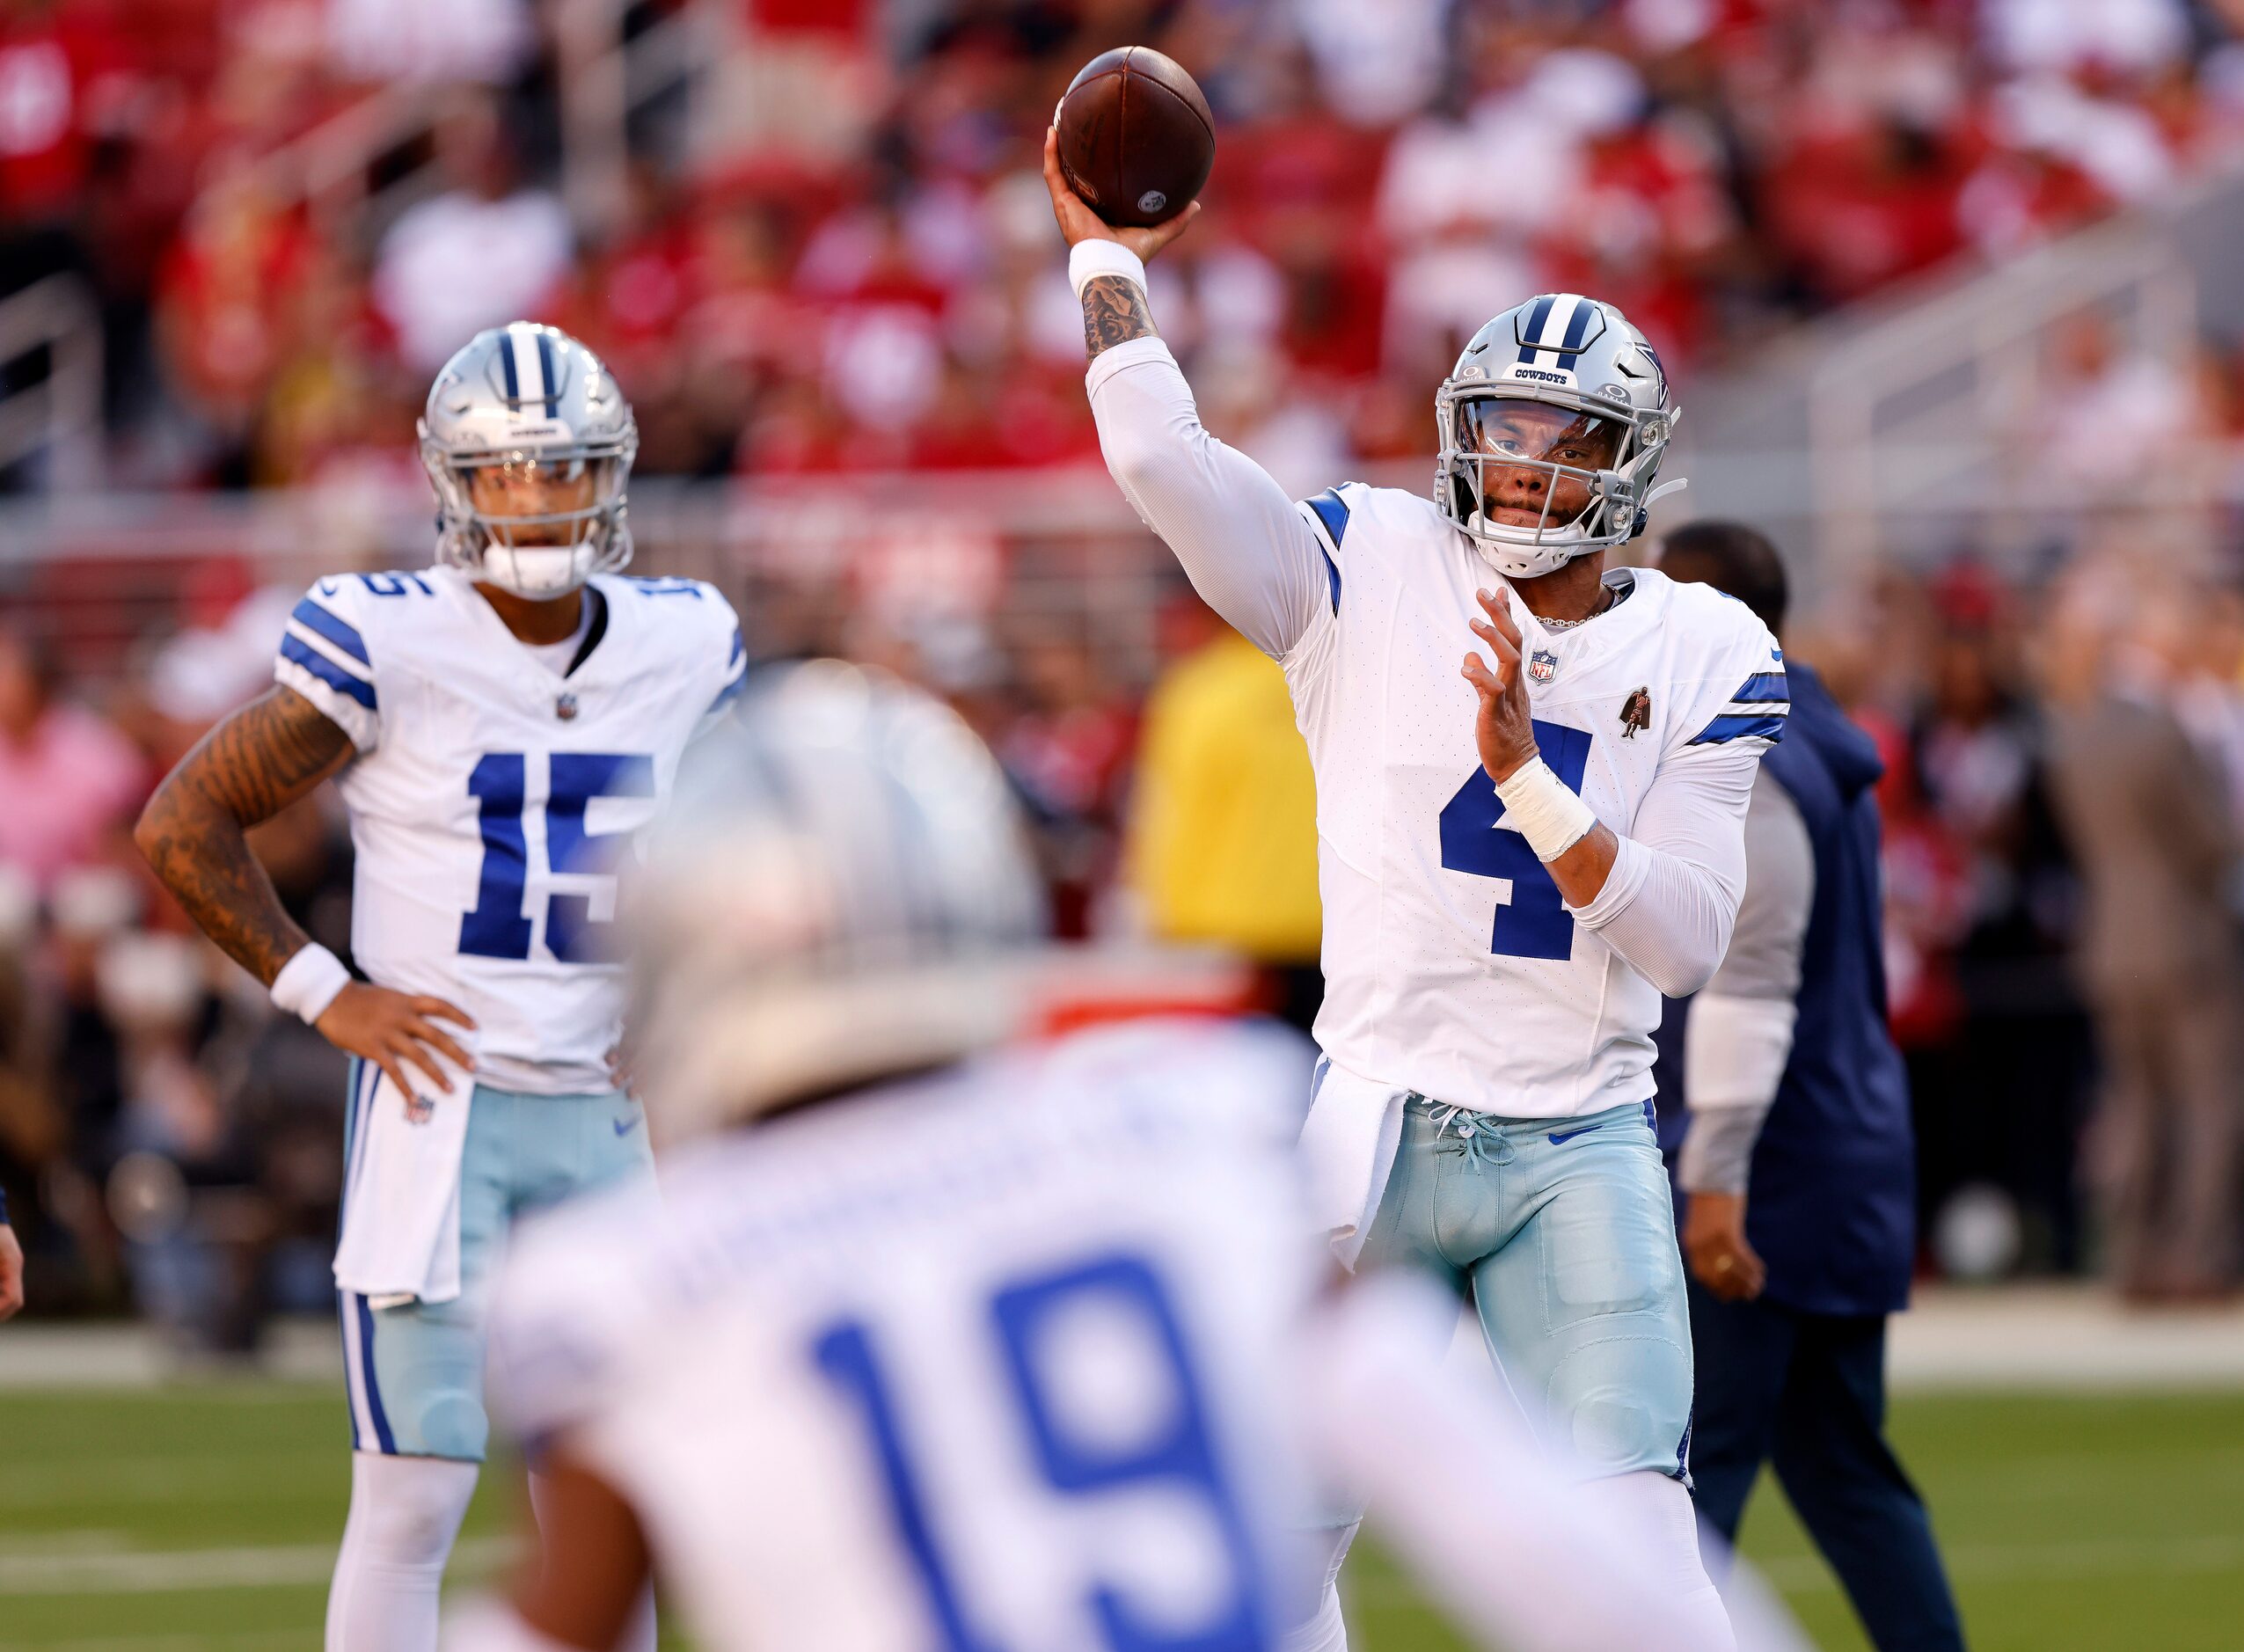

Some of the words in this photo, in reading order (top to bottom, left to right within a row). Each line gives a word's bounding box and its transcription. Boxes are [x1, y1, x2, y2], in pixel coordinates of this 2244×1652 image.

[1515, 369, 1568, 384] COWBOYS
[1531, 662, 1553, 678] NFL
[457, 751, 656, 963] 15
[1439, 718, 1593, 961] 4
[808, 1249, 1271, 1652] 19
